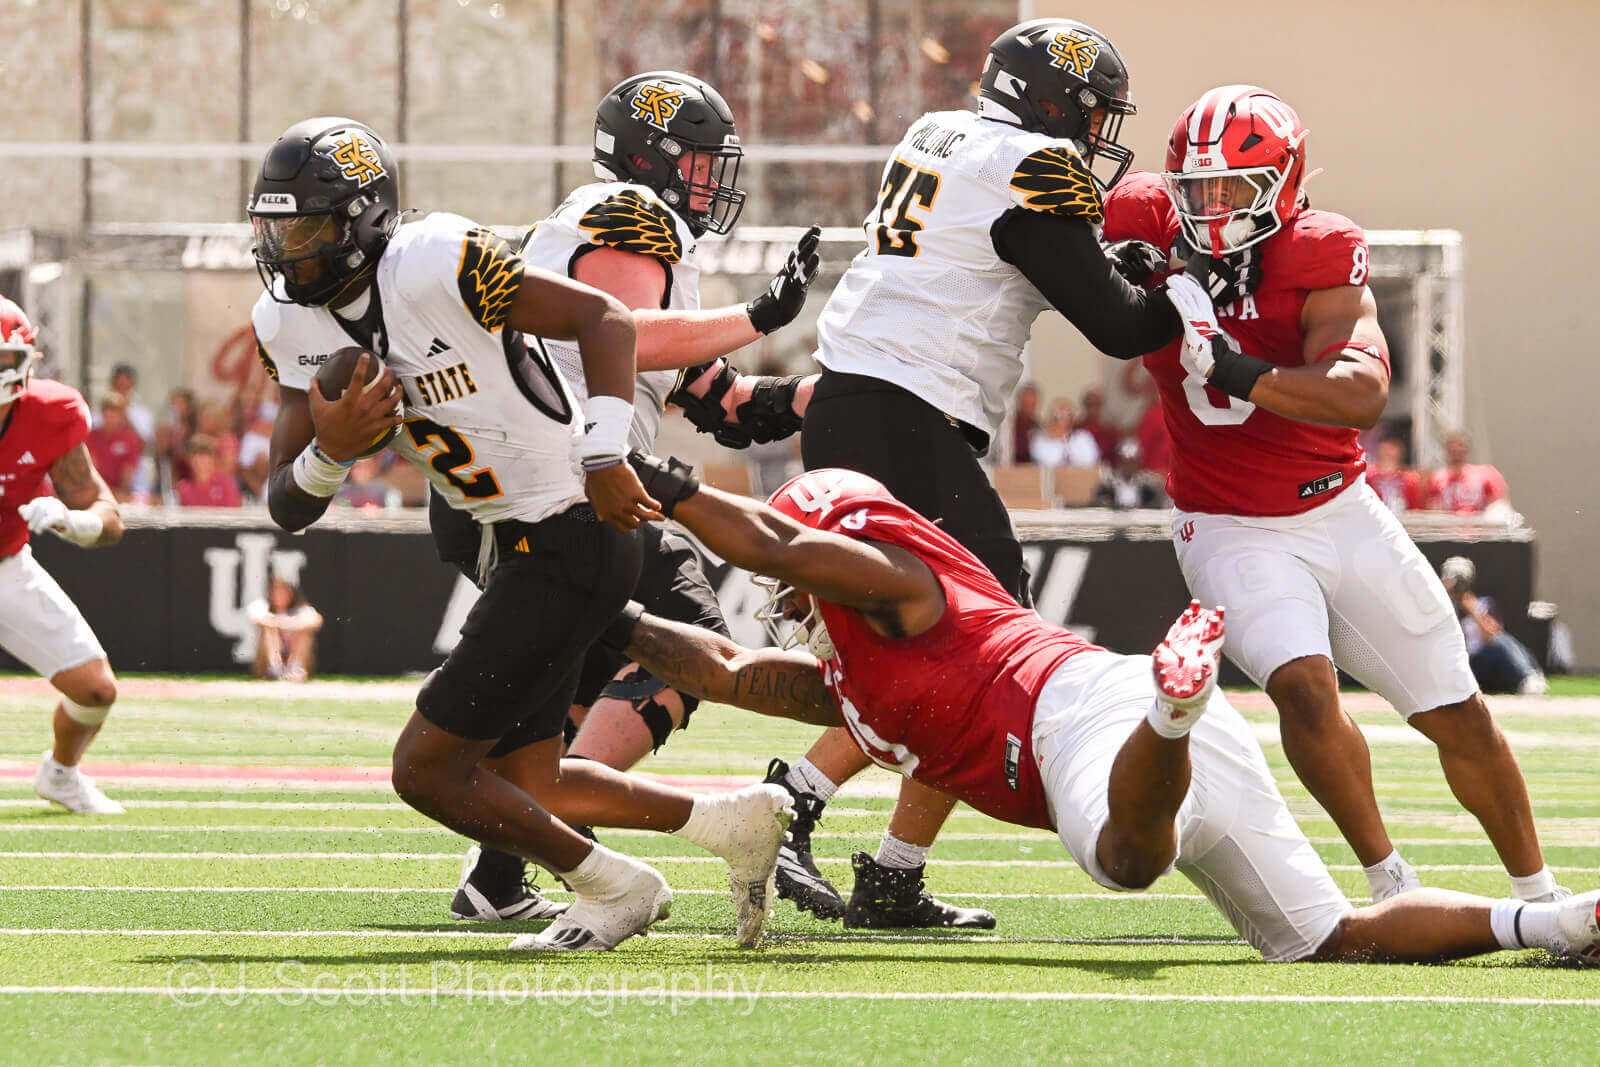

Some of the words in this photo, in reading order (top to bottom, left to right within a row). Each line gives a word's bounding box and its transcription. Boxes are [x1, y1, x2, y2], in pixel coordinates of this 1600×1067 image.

[1349, 246, 1369, 286] 8
[414, 361, 479, 407] STATE
[402, 416, 504, 500] 2
